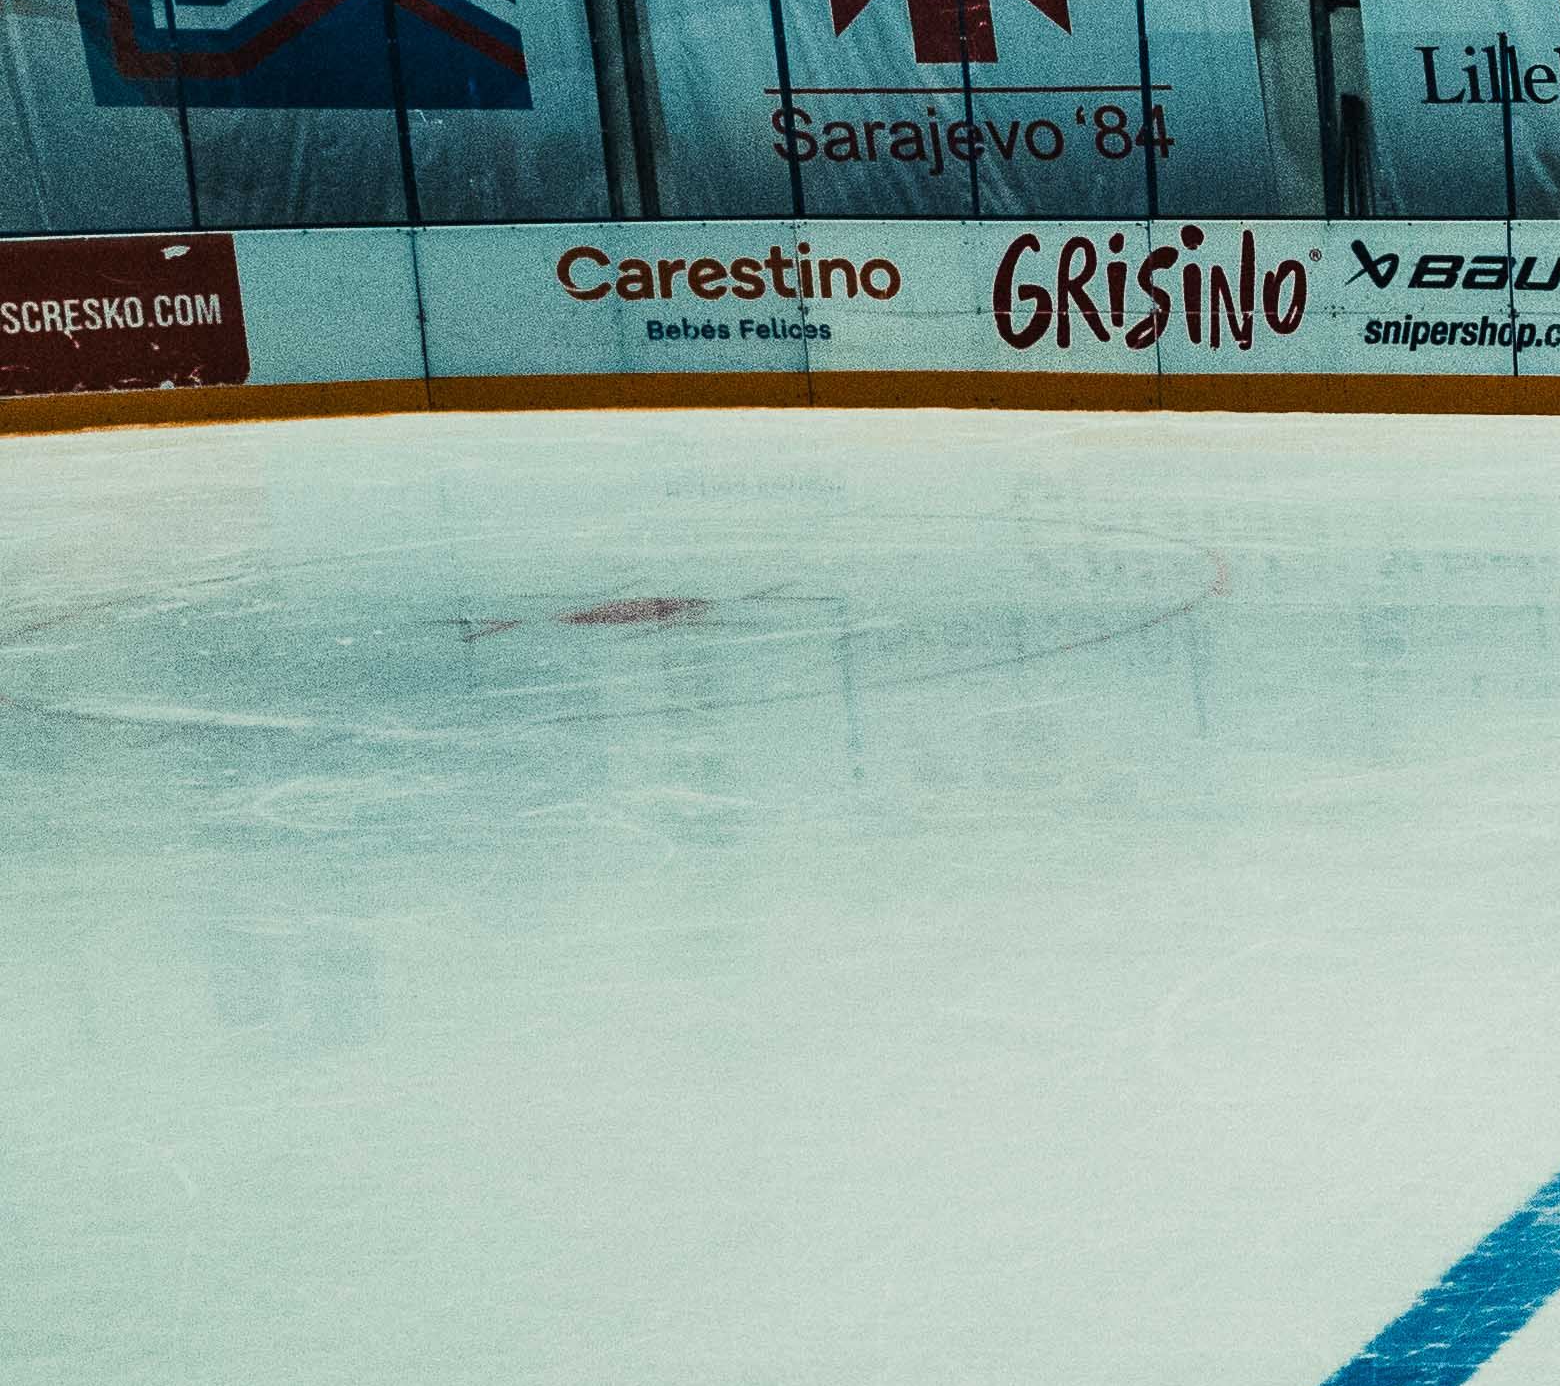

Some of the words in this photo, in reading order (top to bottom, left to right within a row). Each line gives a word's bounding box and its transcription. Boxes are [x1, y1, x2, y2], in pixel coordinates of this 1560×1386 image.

[771, 105, 1065, 176] Sarajevo
[555, 242, 903, 302] Carestino
[0, 294, 222, 334] SCRESKO.COM
[645, 319, 732, 341] Bebés
[739, 319, 832, 341] Felices
